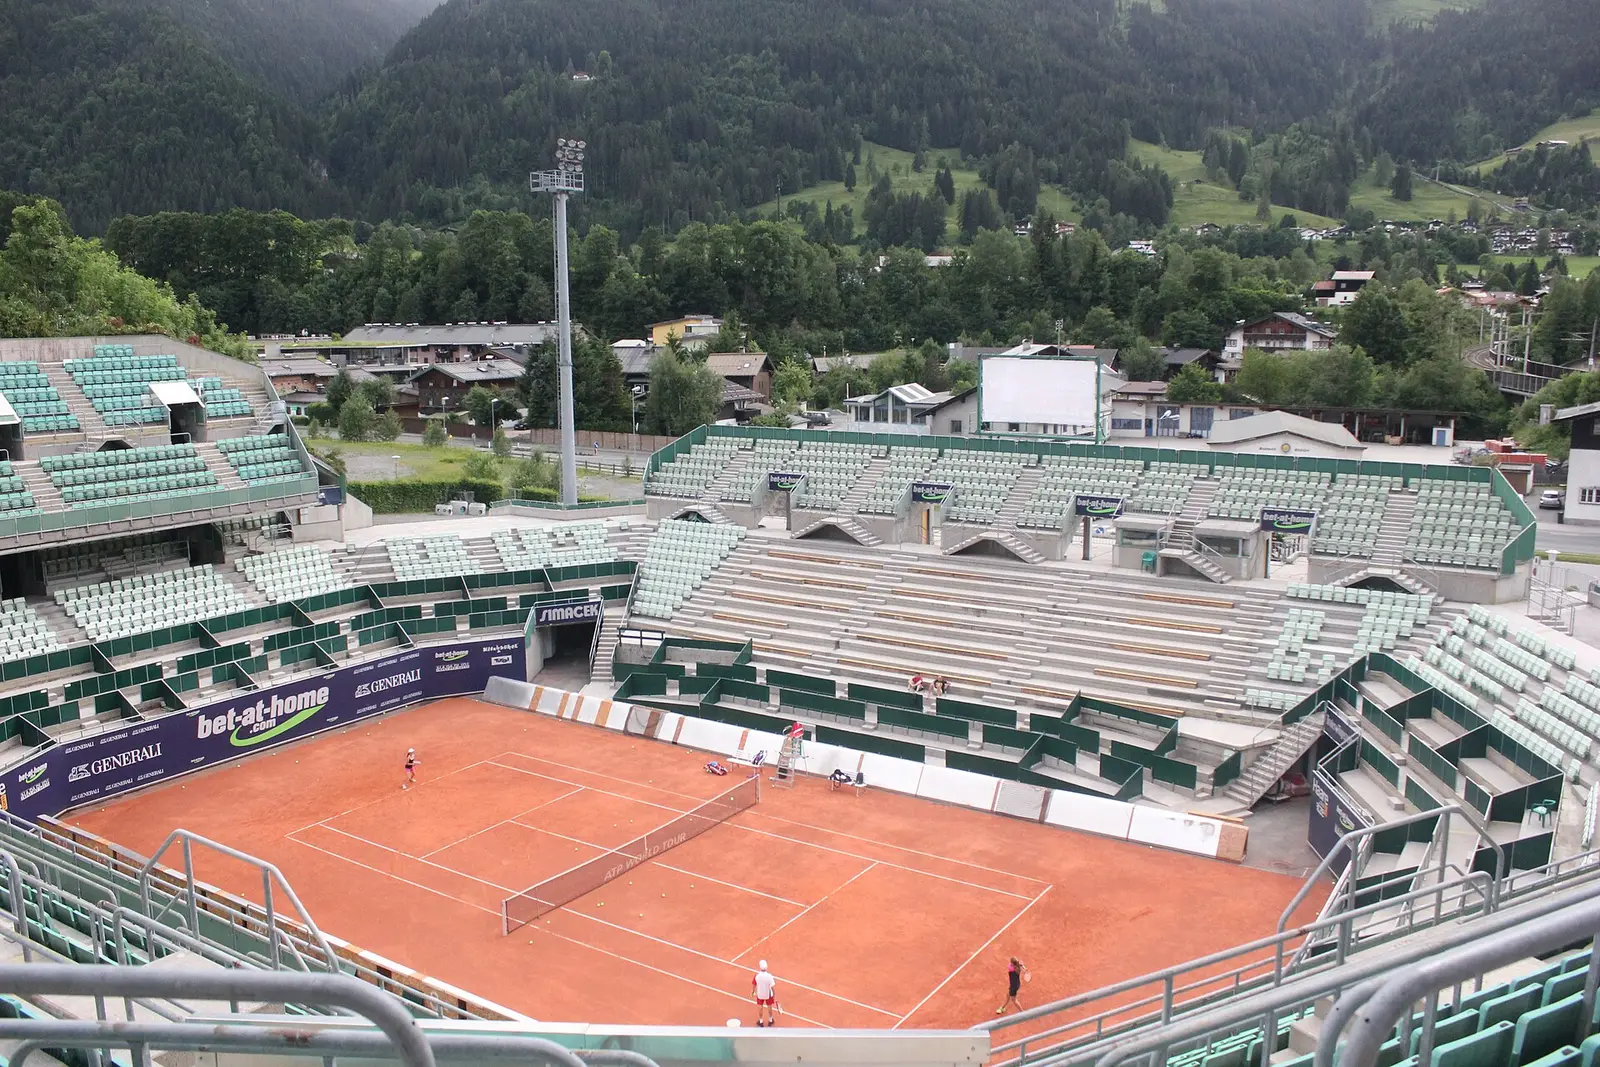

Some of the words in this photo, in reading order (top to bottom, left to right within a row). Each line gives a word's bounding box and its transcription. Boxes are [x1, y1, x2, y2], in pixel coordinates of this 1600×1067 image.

[770, 475, 801, 484] bet-at-hom
[913, 485, 949, 495] bet-at-hom
[540, 604, 599, 622] SIMACEK
[371, 669, 421, 693] GENERALI
[197, 686, 330, 739] bet-at-home
[249, 718, 276, 734] .com
[91, 742, 162, 775] GENERALI
[604, 864, 623, 881] ATP
[625, 845, 660, 869] WORLD
[663, 832, 687, 850] TOUR
